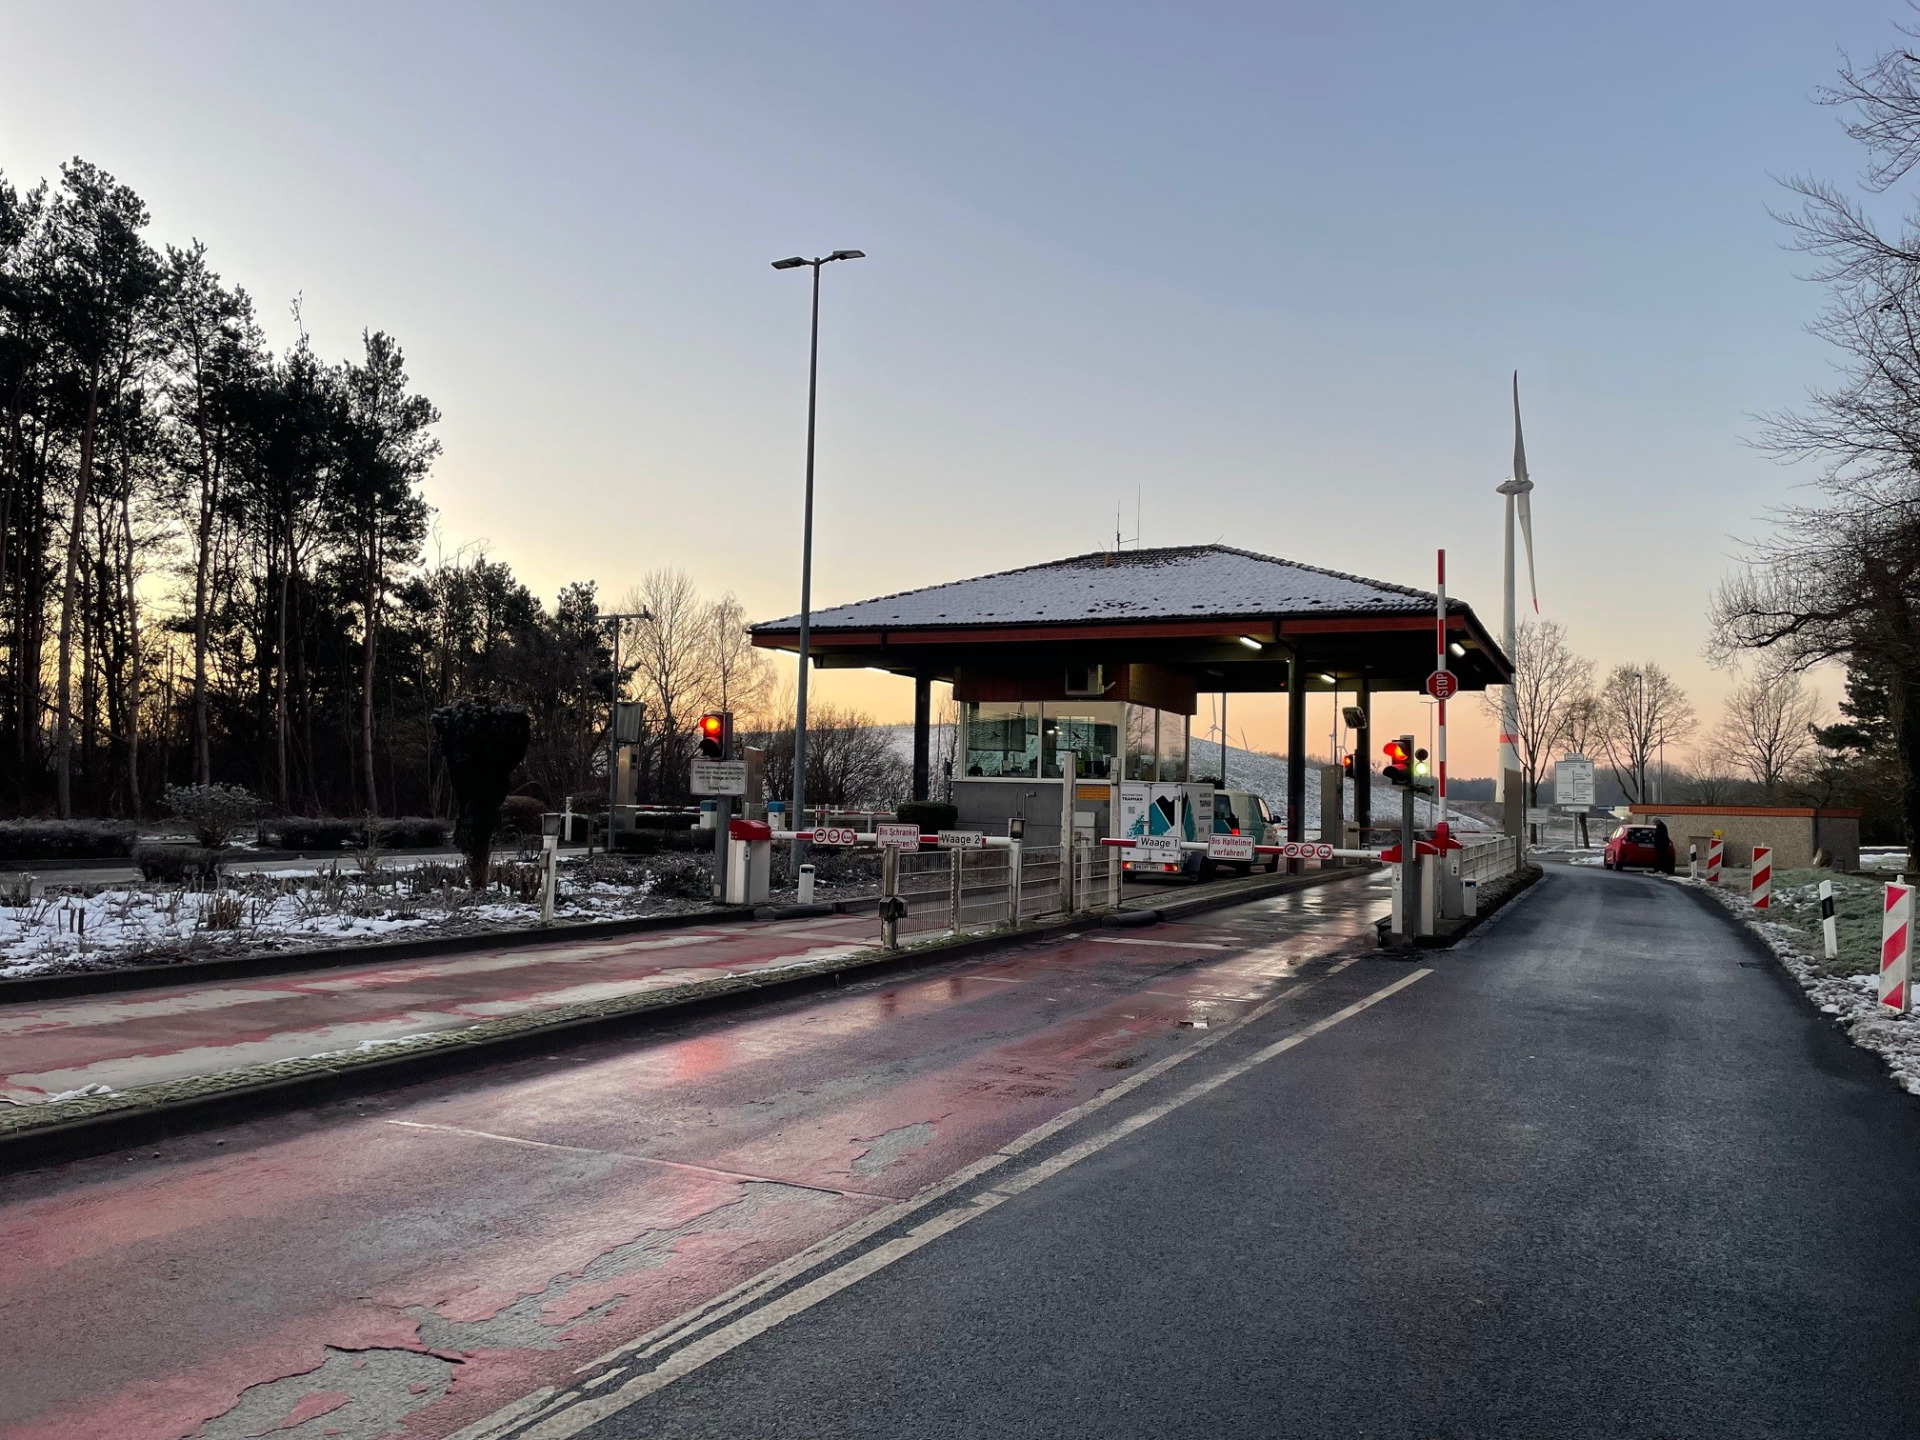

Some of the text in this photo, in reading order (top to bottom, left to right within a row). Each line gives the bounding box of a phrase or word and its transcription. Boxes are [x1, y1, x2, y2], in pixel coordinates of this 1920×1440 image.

[1436, 673, 1449, 697] STOP
[879, 827, 917, 837] Bis Schranke
[940, 833, 981, 846] Waage 2
[1140, 837, 1178, 849] Waage 1
[1211, 836, 1252, 847] Bis Haltelinie
[1213, 848, 1247, 857] vorfahren!
